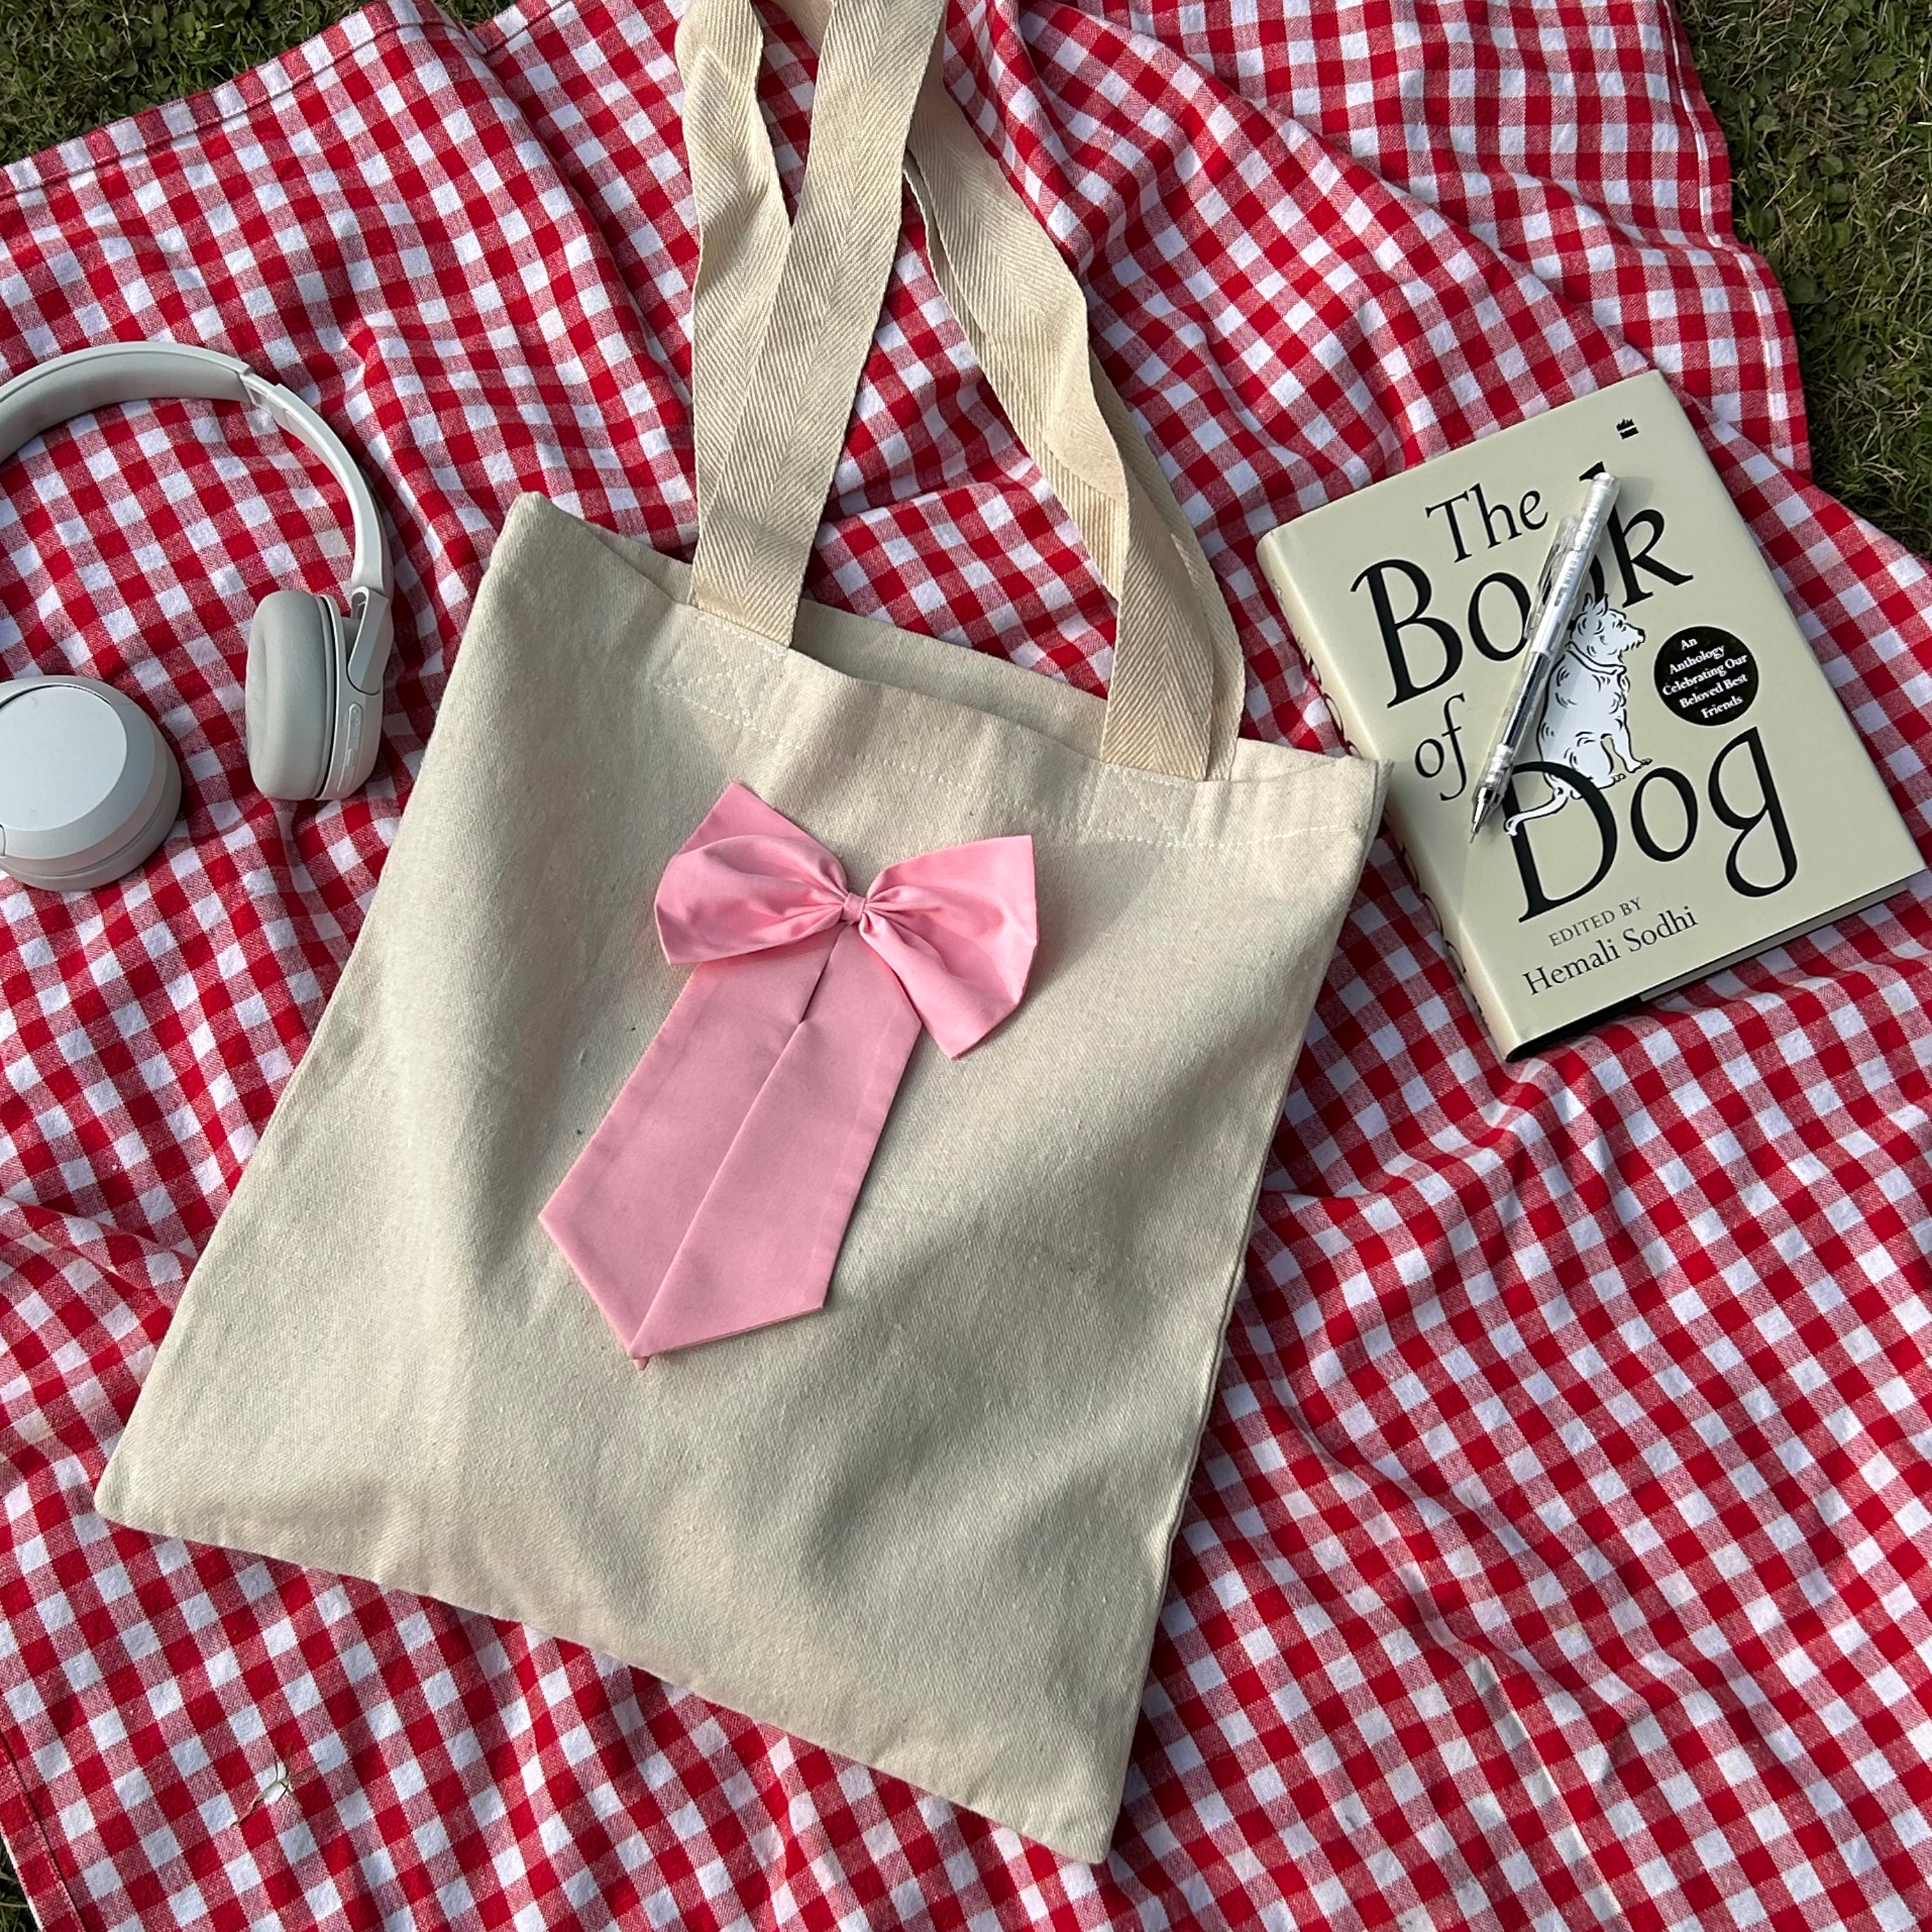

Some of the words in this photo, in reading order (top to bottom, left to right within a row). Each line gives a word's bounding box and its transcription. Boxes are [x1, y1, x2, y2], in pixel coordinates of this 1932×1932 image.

[1425, 483, 1549, 563] The
[1669, 645, 1725, 675] Anthology
[1681, 638, 1698, 651] An
[1662, 664, 1728, 696] Celebrating
[1725, 655, 1748, 669] Our
[1679, 682, 1724, 708] Beloved
[1723, 673, 1749, 689] Best
[1701, 696, 1744, 718] Friends
[1414, 693, 1467, 802] of
[1502, 726, 1798, 923] Dog
[1548, 910, 1616, 947] EDITED
[1618, 896, 1642, 917] BY
[1522, 938, 1621, 996] Hemali
[1623, 905, 1699, 953] Sodhi
